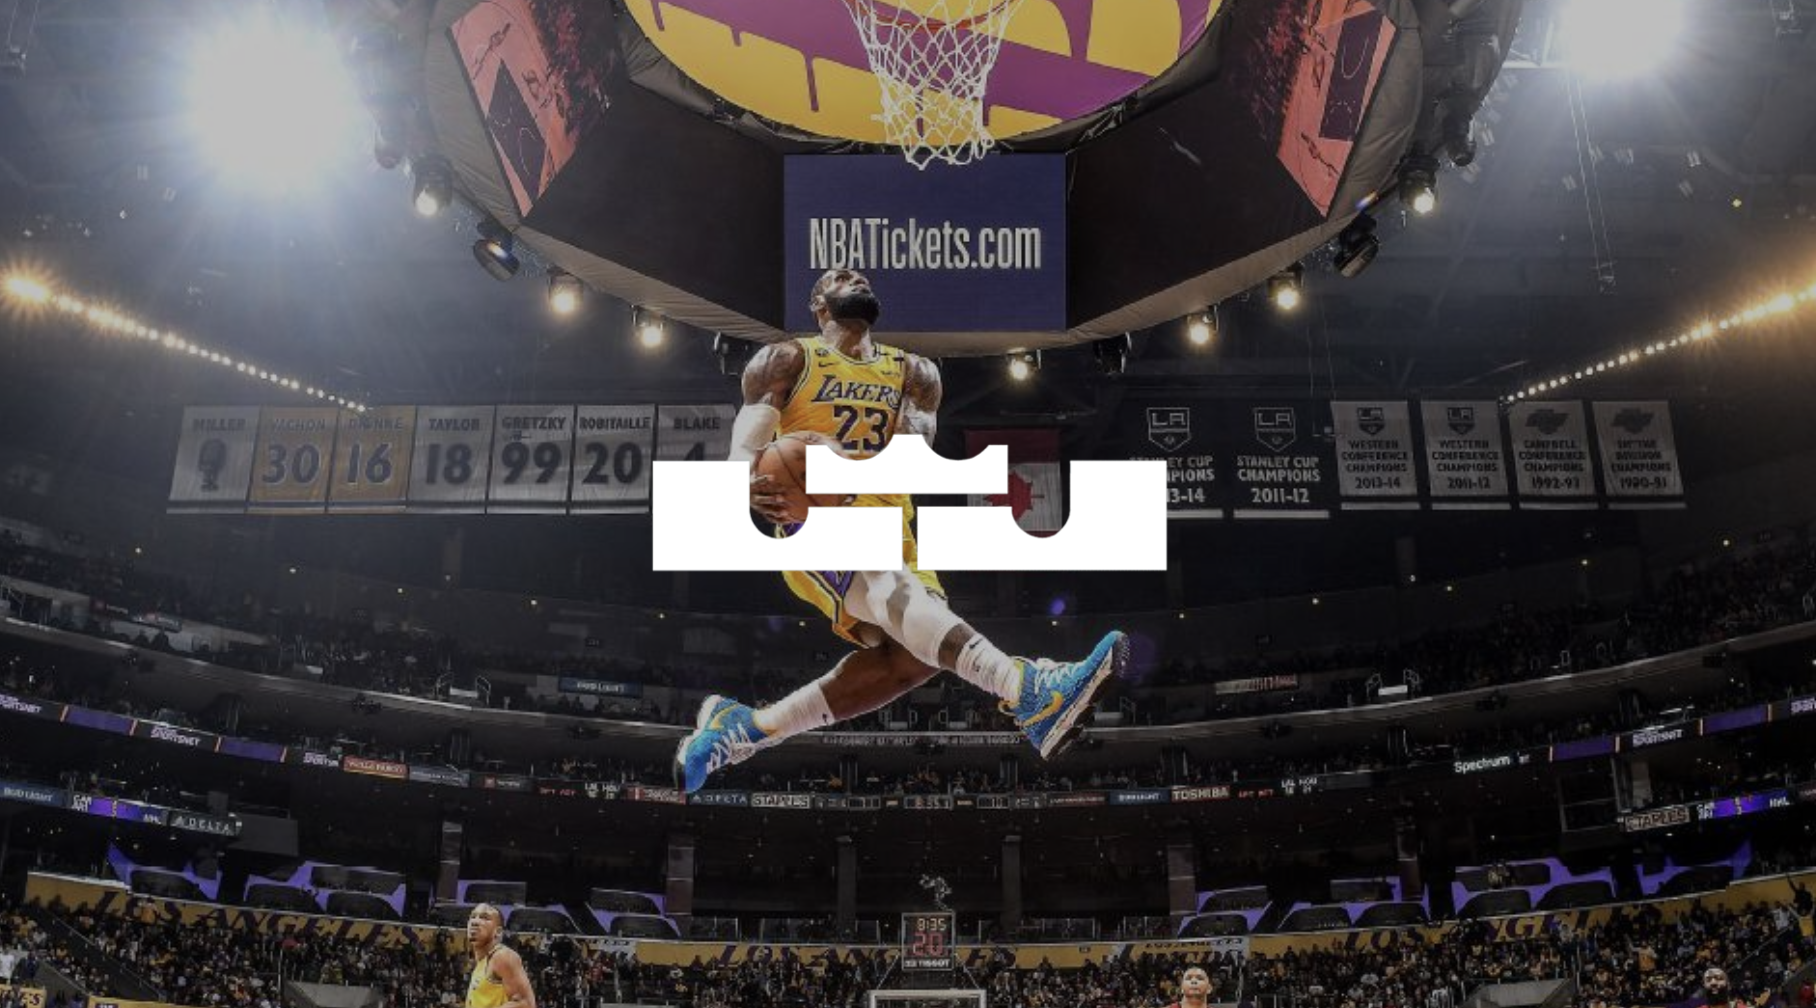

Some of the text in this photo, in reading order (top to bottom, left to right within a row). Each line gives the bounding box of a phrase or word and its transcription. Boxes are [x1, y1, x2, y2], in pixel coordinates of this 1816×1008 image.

[809, 217, 1042, 270] NBATickets.com
[811, 374, 902, 409] LAKERS
[193, 418, 246, 431] MILLER
[428, 417, 480, 431] TAYLOR
[501, 416, 567, 430] GRETZKY
[578, 416, 651, 430] ROBITAILLE
[672, 416, 721, 430] BLAKE
[1151, 412, 1187, 426] LA
[1257, 412, 1292, 426] LA
[833, 405, 889, 453] 23
[1347, 439, 1399, 449] WESTERN
[1439, 439, 1490, 449] WESTERN
[501, 441, 562, 485] 99
[581, 441, 643, 485] 20
[1187, 455, 1213, 468] CUP
[1237, 455, 1320, 468] STANLEY CUP
[1341, 451, 1409, 461] CONFERENCE
[1431, 451, 1500, 461] CONFERENCE
[1518, 451, 1586, 461] CONFERENCE
[262, 443, 320, 484] 30
[347, 442, 393, 485] 16
[426, 442, 473, 485] 18
[1345, 462, 1408, 473] CHAMPIONS
[1436, 462, 1499, 473] CHAMPIONS
[1523, 462, 1585, 473] CHAMPIONS
[1610, 462, 1672, 473] CHAMPIONS
[1238, 468, 1321, 482] CHAMPIONS
[1354, 476, 1401, 490] 2013-14
[1447, 476, 1491, 490] 2011-12
[1167, 487, 1206, 503] 13-14
[1251, 487, 1310, 504] 2011-12
[1453, 755, 1511, 775] Spectrum
[704, 794, 747, 804] DELTA
[752, 794, 809, 807] STAPLES
[1173, 787, 1230, 800] TOSHIBA
[188, 817, 230, 833] DELTA
[1626, 807, 1688, 832] STAPLES
[916, 917, 947, 931] 8:35
[912, 931, 944, 957] 20
